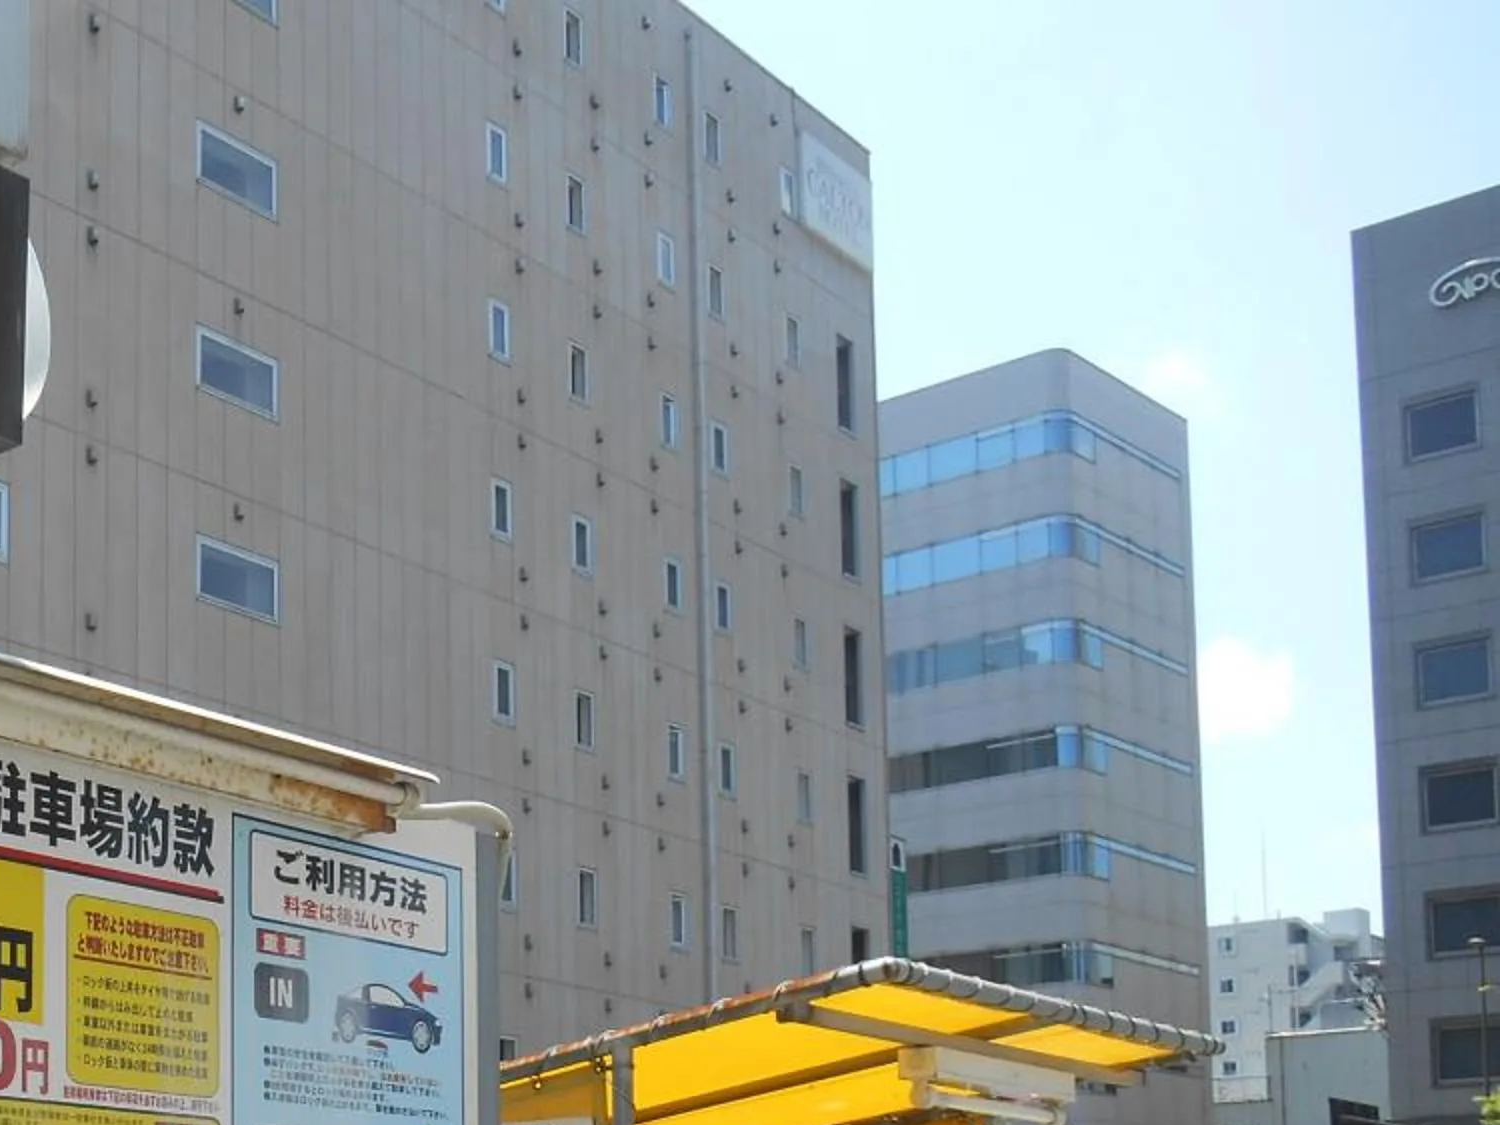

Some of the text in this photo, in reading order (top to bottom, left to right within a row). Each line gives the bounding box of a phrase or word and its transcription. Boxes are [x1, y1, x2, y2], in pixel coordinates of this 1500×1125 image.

[274, 850, 428, 915] ご利用方法
[283, 895, 420, 940] 料金は後払いです
[269, 976, 293, 1009] IN
